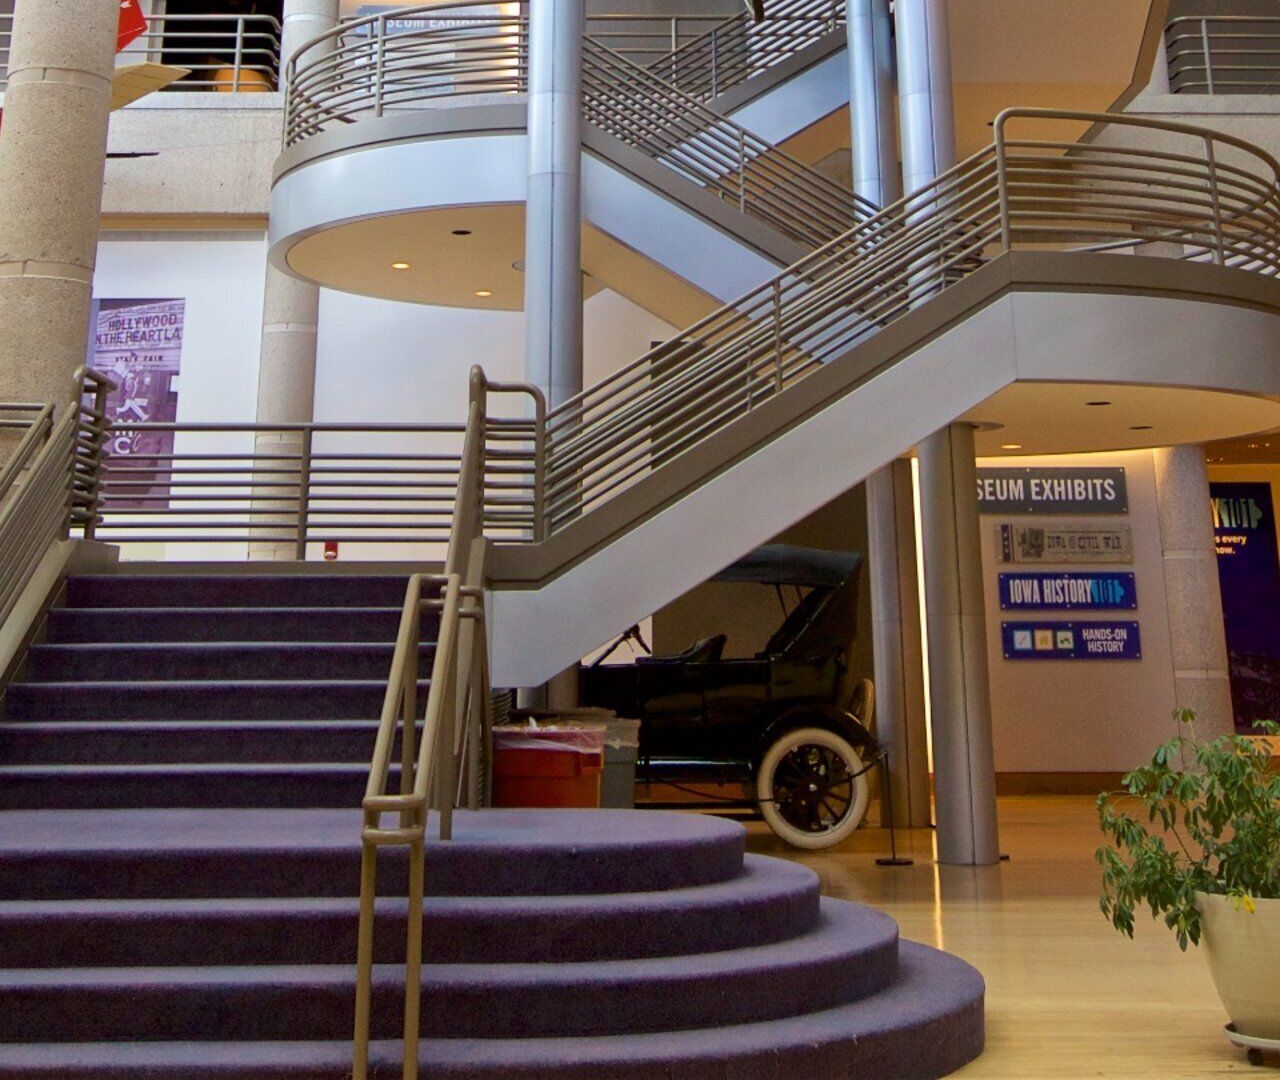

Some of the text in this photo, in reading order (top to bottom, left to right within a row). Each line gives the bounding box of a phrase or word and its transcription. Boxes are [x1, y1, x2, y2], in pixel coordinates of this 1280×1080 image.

[109, 313, 178, 331] HOLLYWOOD
[1031, 479, 1116, 501] EXHIBITS
[1222, 535, 1247, 545] every
[1009, 579, 1041, 603] IOWA
[1043, 579, 1092, 603] HISTORY
[1082, 628, 1127, 641] HANDS-ON
[1087, 640, 1124, 653] HISTORY
